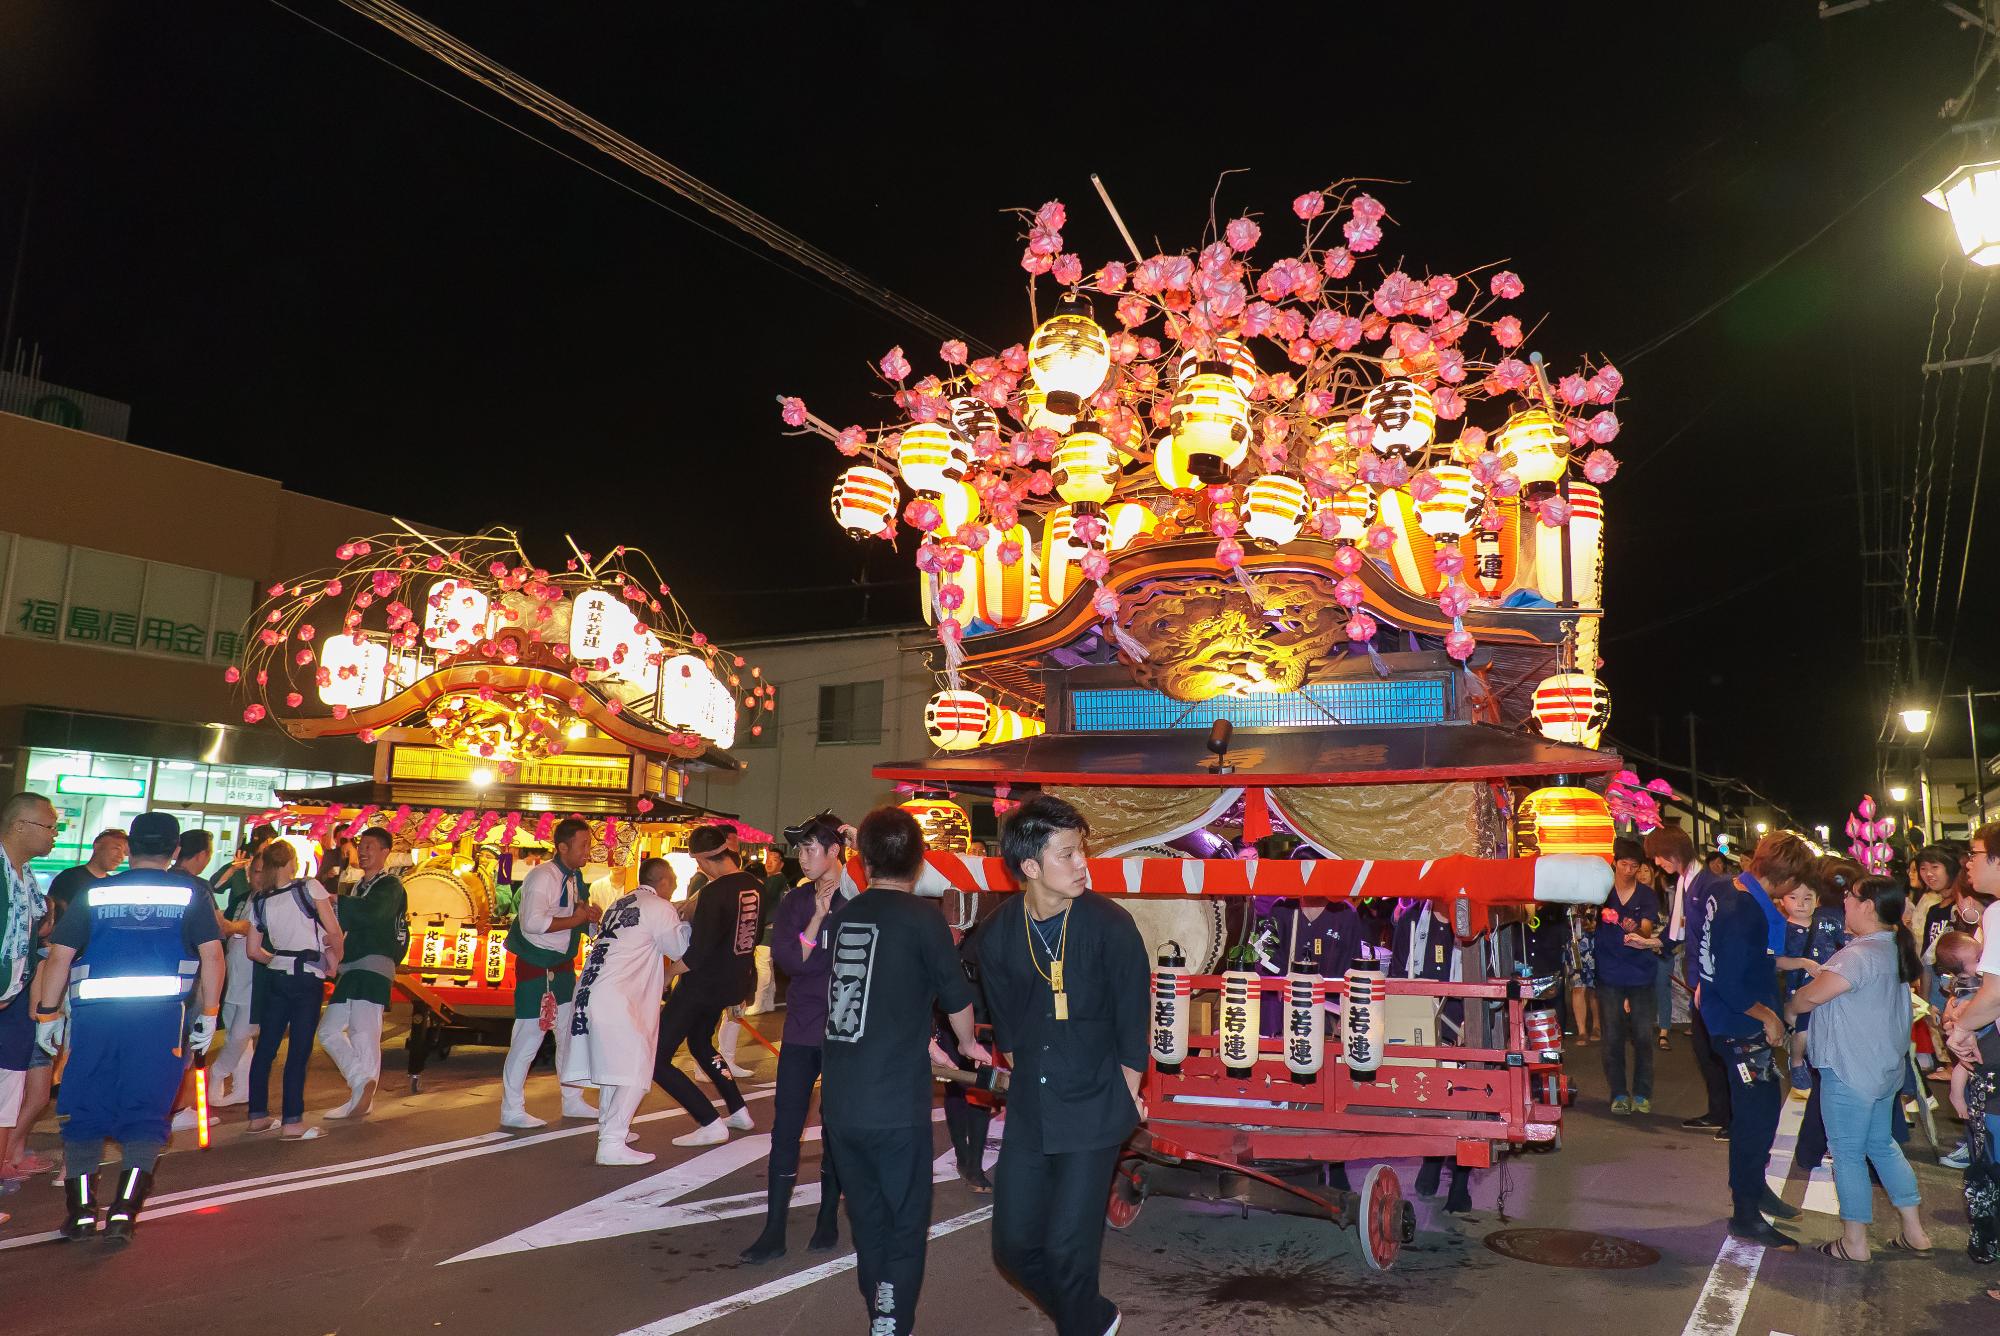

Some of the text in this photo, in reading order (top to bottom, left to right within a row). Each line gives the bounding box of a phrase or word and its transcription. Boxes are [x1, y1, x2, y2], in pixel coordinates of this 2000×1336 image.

[1370, 382, 1412, 433] 若
[18, 600, 245, 659] 福島信用金庫
[98, 907, 127, 919] FIRE
